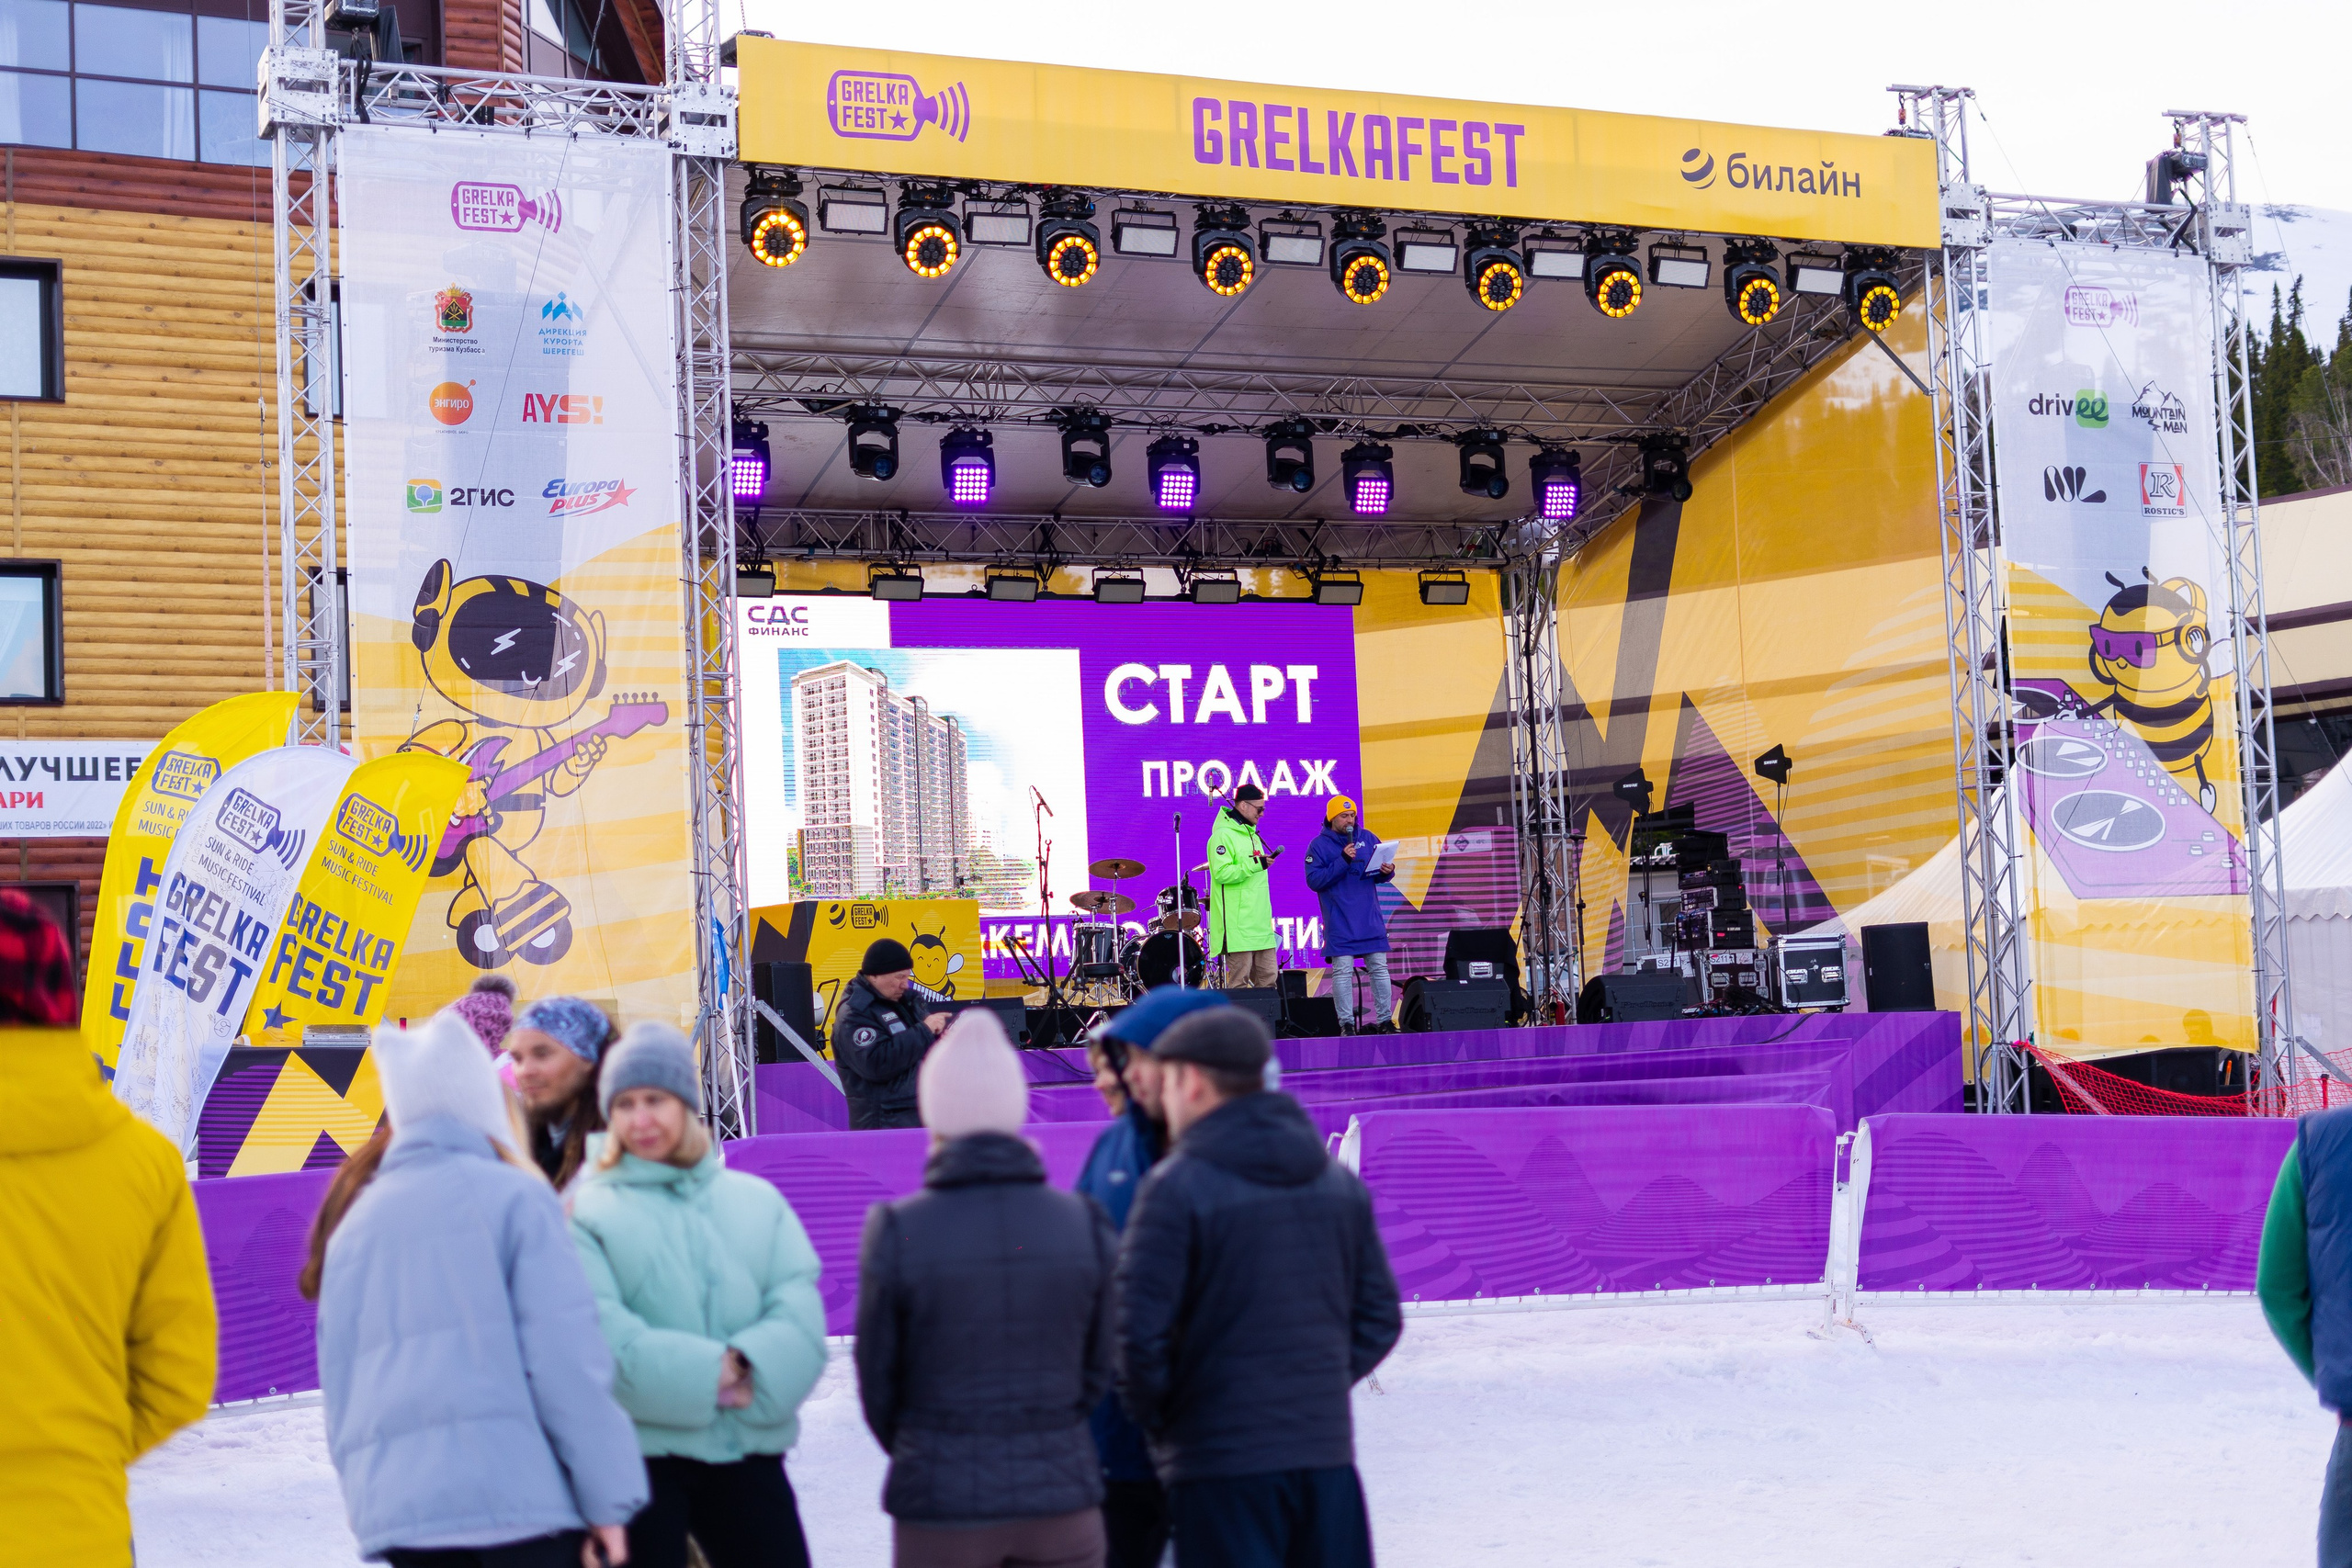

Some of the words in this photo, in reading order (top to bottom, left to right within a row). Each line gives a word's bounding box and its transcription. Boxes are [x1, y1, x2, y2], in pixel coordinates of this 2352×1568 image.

[842, 80, 909, 106] GRELKA
[842, 106, 888, 130] FEST
[1193, 96, 1525, 188] GRELKAFEST
[1727, 152, 1861, 198] билайн
[462, 188, 514, 207] GRELKA
[463, 207, 498, 224] FEST
[2072, 292, 2108, 307] GRELKA
[2073, 307, 2096, 321] FEST
[433, 336, 478, 344] Министерство
[538, 328, 587, 336] ДИРЕКЦИЯ
[543, 337, 583, 345] КУРОРТА
[543, 347, 584, 355] ШЕРЕГЕШ
[434, 399, 469, 412] энгиро
[523, 393, 604, 424] AYS!
[2029, 393, 2109, 422] drivee
[2132, 406, 2187, 422] MOUNTAIN
[2163, 422, 2188, 434] MAN
[450, 488, 514, 507] 2ГИС
[2143, 507, 2185, 515] ROSTIC'S
[747, 605, 808, 626] СДС
[748, 626, 808, 636] ФИНАНС
[1104, 663, 1318, 725] СТАРТ
[166, 758, 212, 779] GRELKA
[160, 773, 191, 792] FEST
[1142, 759, 1340, 801] ПРОДАЖ
[142, 801, 166, 816] SUN
[166, 807, 175, 819] &
[232, 795, 275, 829] GRELKA
[350, 800, 392, 834] GRELKA
[15, 820, 51, 830] ТОВАРОВ
[53, 820, 85, 830] РОССИИ
[86, 820, 107, 829] 2022»
[138, 818, 174, 839] MUSIC
[222, 812, 254, 840] FEST
[342, 815, 373, 841] FEST
[205, 836, 226, 857] SUN
[224, 849, 232, 862] &
[232, 854, 255, 875] RIDE
[327, 840, 348, 859] SUN
[347, 852, 355, 864] &
[356, 856, 379, 877] RIDE
[198, 853, 228, 884] MUSIC
[227, 873, 266, 907] FESTIVAL
[321, 856, 353, 882] MUSIC
[351, 874, 393, 906] FESTIVAL
[165, 871, 270, 962] GRELKA
[855, 917, 867, 925] FEST
[287, 892, 395, 971] GRELKA
[153, 916, 254, 1017] FEST
[268, 932, 384, 1017] FEST
